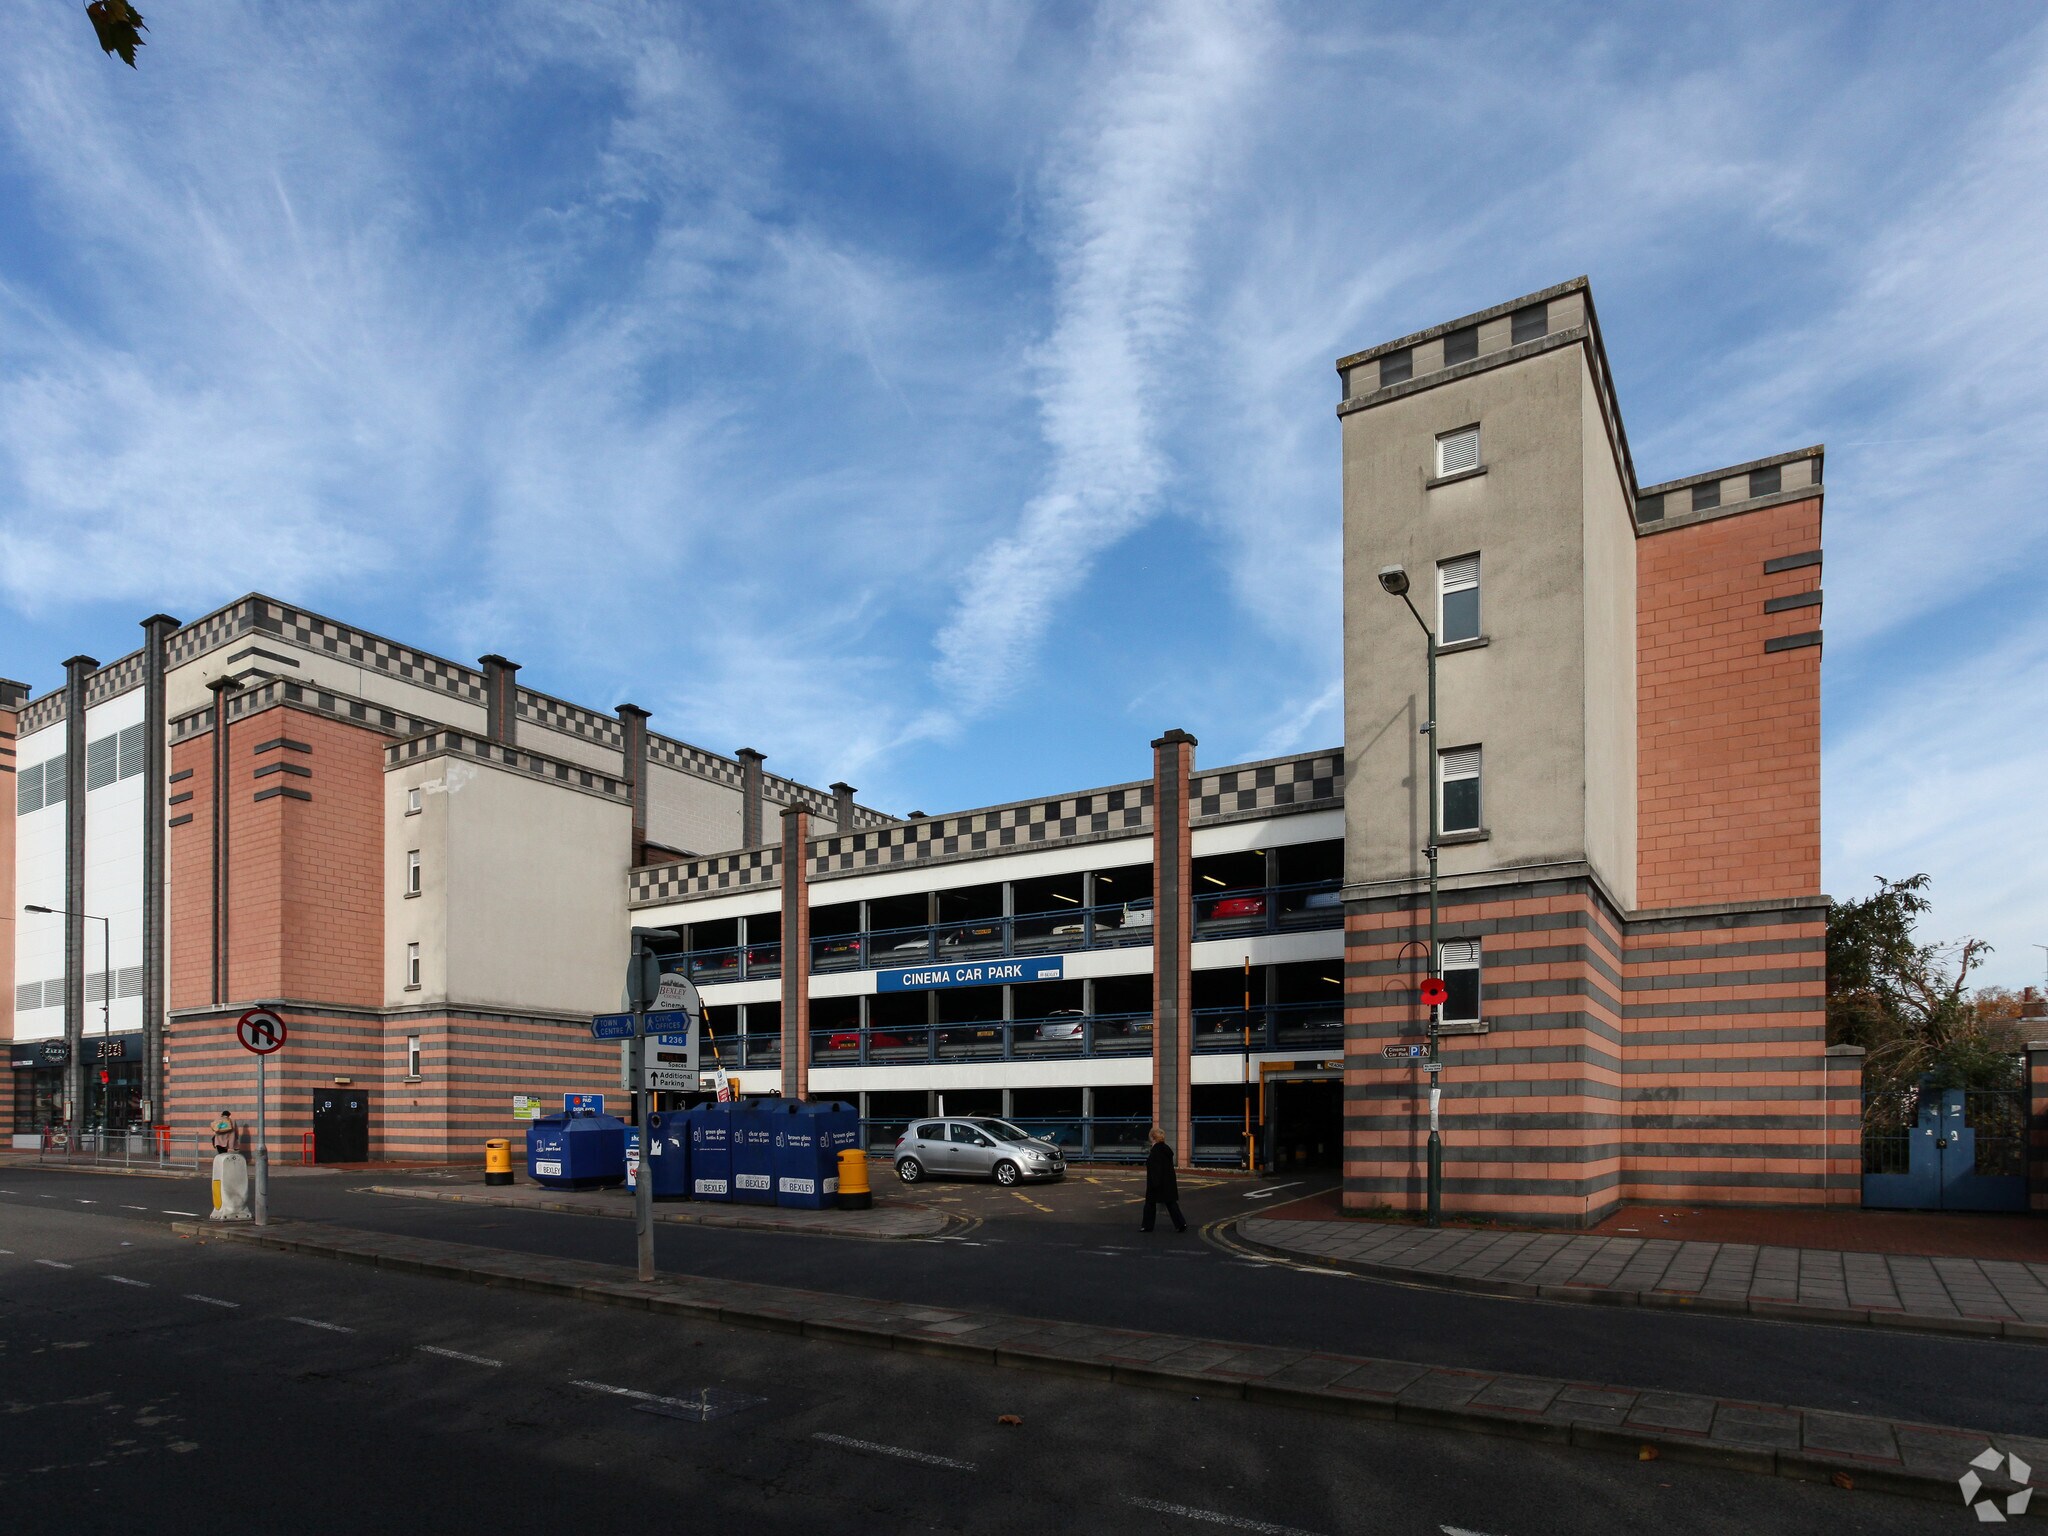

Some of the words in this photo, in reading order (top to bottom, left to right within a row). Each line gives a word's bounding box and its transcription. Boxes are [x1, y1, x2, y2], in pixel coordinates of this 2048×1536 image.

[903, 971, 950, 985] CINEMA
[956, 968, 982, 981] CAR
[988, 964, 1022, 979] PARK
[660, 986, 686, 995] BEXLEY
[600, 1019, 618, 1027] TOWN
[655, 1022, 681, 1030] OFFICES
[600, 1027, 624, 1036] CENTRE
[668, 1036, 683, 1044] 236
[1410, 1046, 1418, 1056] P
[543, 1166, 561, 1174] BEXLEY
[703, 1184, 727, 1192] BEXLEY
[745, 1180, 769, 1188] BEXLEY
[790, 1183, 813, 1192] BEXLEY
